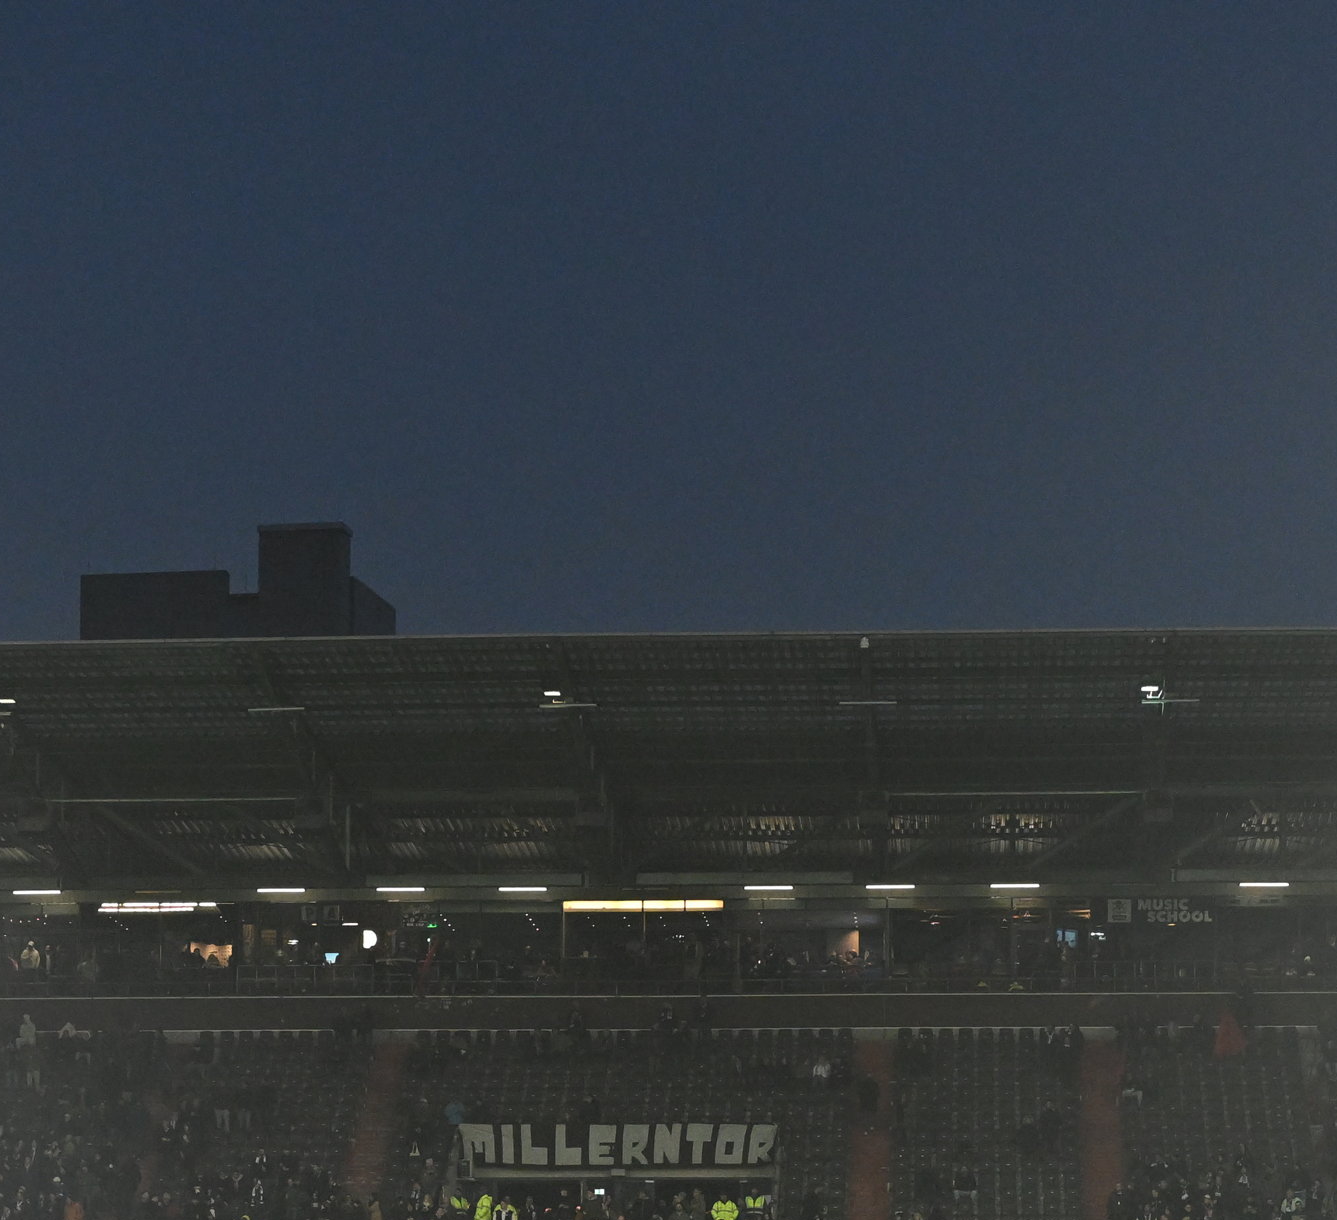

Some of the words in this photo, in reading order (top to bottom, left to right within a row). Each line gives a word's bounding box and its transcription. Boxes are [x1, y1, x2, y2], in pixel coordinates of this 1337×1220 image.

[1137, 899, 1188, 910] MUSIC
[1147, 911, 1212, 923] SCHOOL
[456, 1123, 777, 1167] MILLERNTOR
